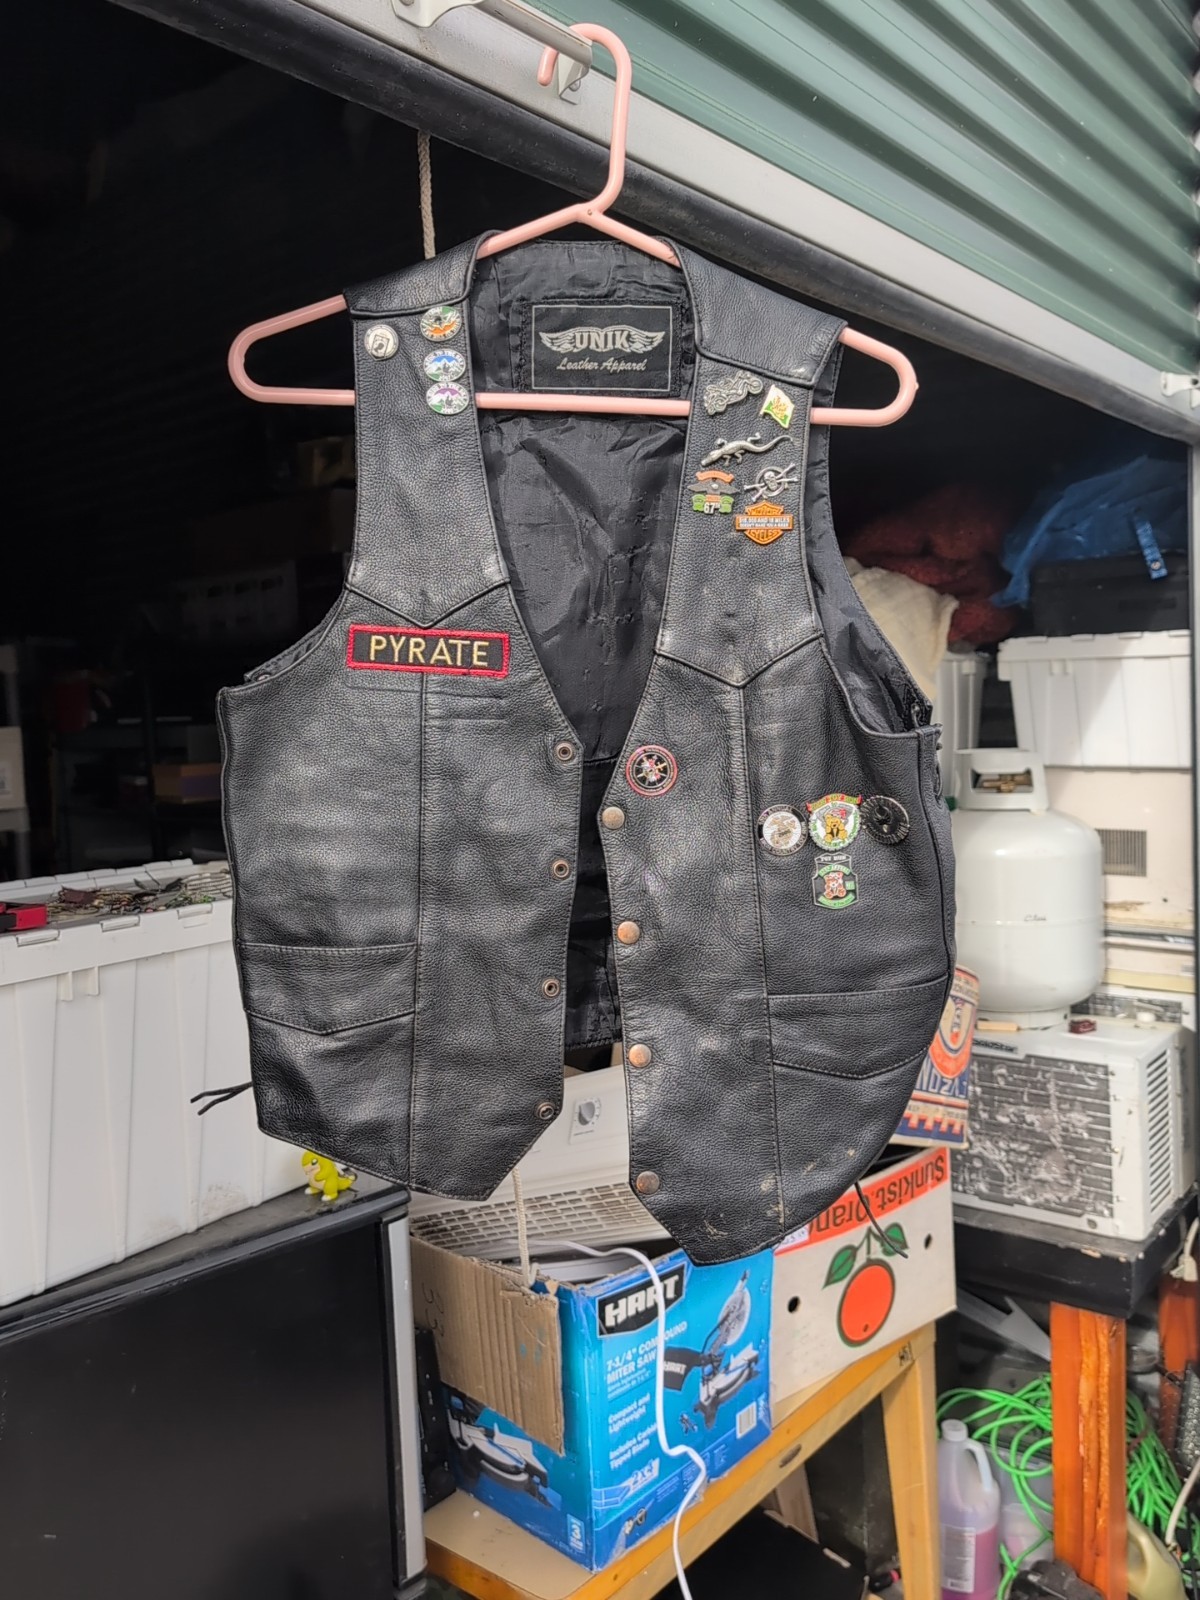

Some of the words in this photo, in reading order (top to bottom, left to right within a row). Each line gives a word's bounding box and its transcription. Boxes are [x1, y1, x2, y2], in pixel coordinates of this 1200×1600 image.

[574, 330, 630, 349] UNIK
[556, 357, 599, 371] Leather
[600, 357, 648, 373] Apparel
[369, 634, 490, 667] PYRATE
[875, 1155, 945, 1210] Sunkist
[808, 1193, 871, 1235] Oran
[604, 1274, 680, 1328] HART
[606, 1361, 636, 1384] MITER
